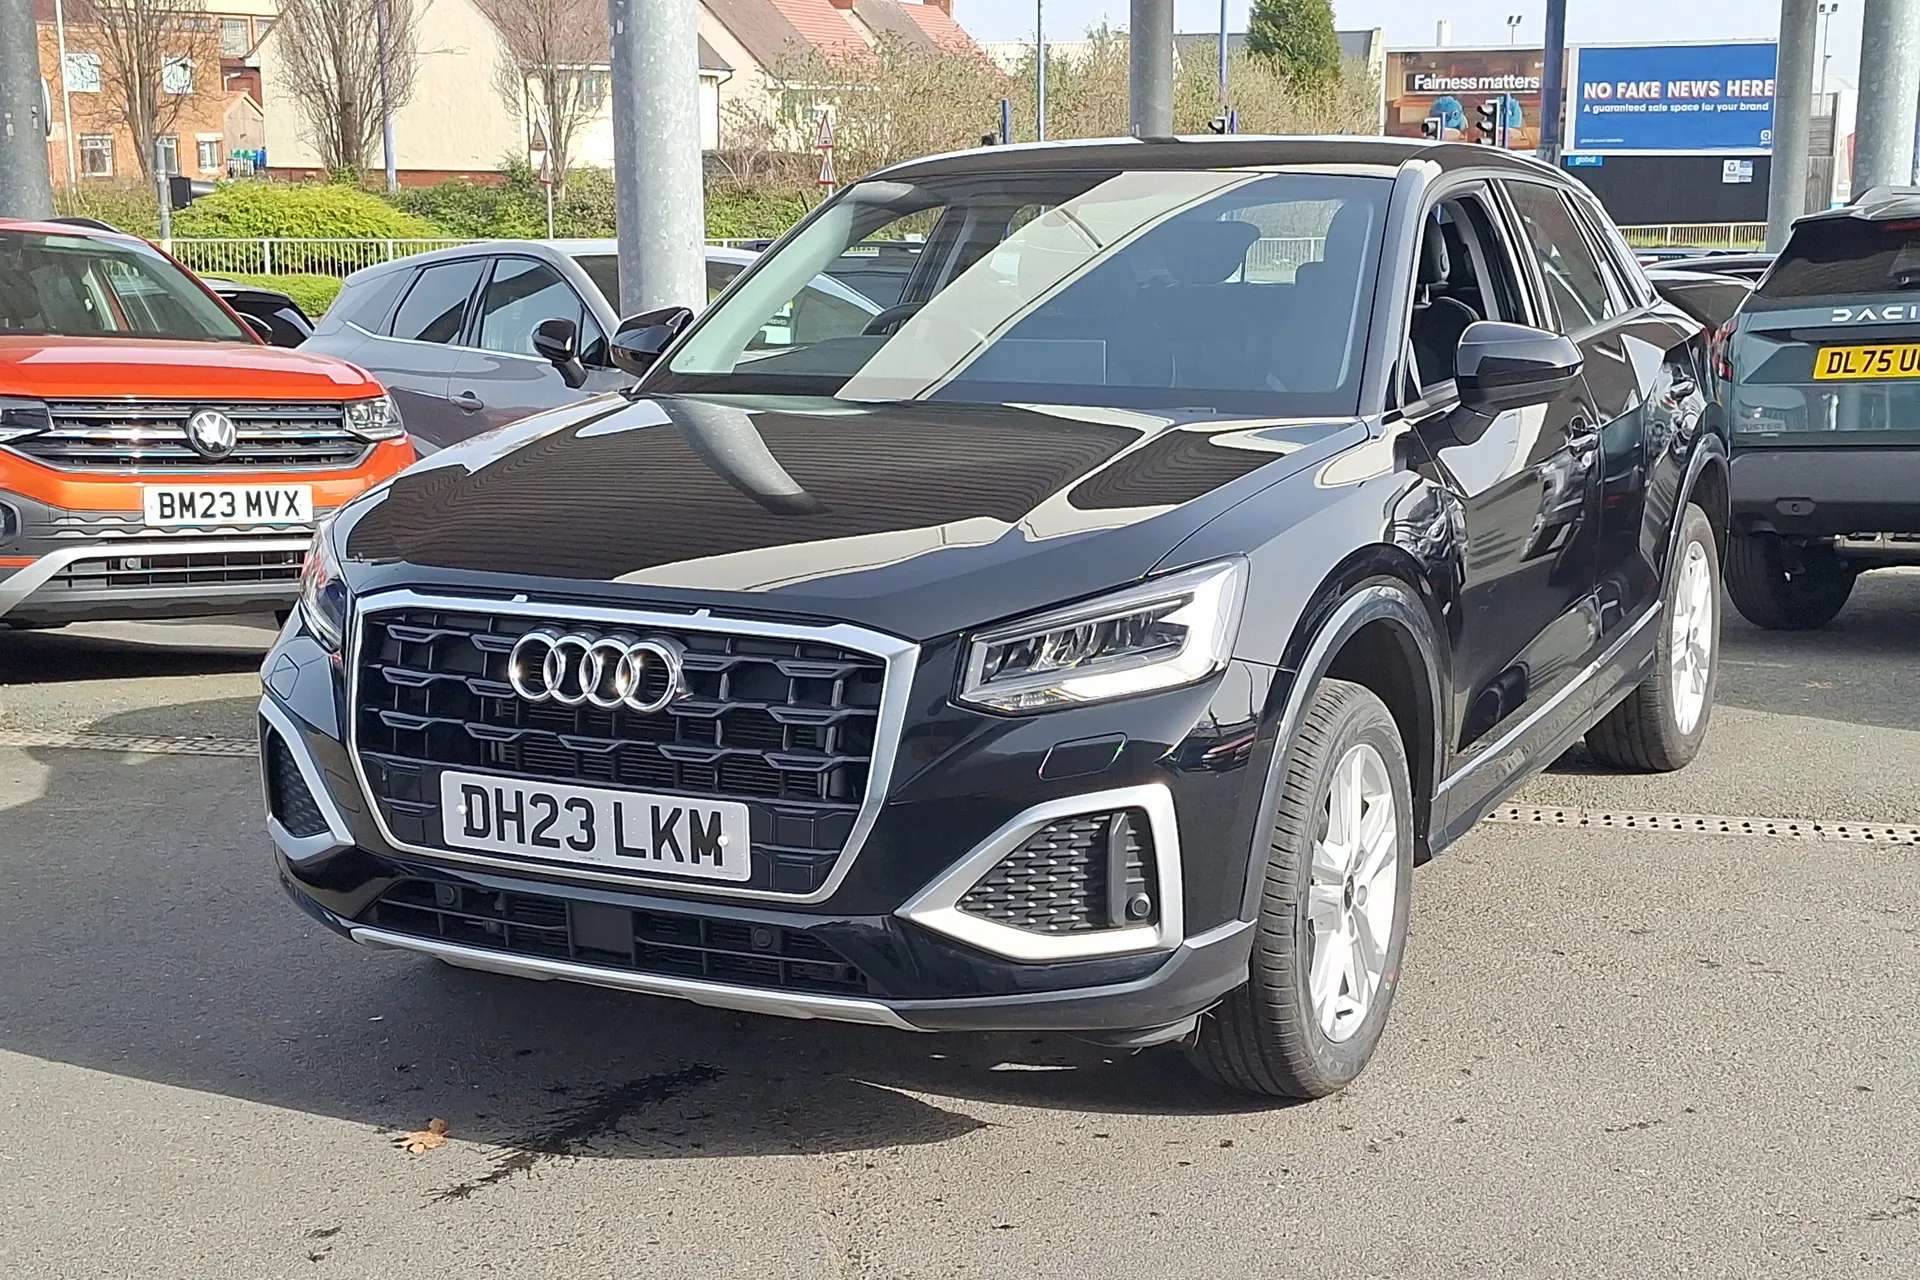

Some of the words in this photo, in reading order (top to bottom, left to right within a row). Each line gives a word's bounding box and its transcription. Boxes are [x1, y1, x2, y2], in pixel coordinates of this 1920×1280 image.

[1414, 73, 1477, 90] Fairness
[1478, 73, 1540, 89] matters
[1583, 82, 1612, 99] NO
[1616, 81, 1660, 99] FAKE
[1667, 80, 1720, 98] NEWS
[1726, 79, 1775, 97] HERE
[1584, 104, 1590, 112] A
[1592, 103, 1646, 114] guaranteed
[1648, 103, 1668, 112] safe
[1670, 103, 1699, 113] space
[1701, 103, 1715, 112] for
[1717, 103, 1739, 113] your
[1740, 102, 1769, 111] brand
[1826, 349, 1894, 375] DL75
[1899, 348, 1920, 372] U
[158, 492, 236, 520] BM23
[246, 490, 301, 518] MVX
[461, 783, 597, 852] DH23
[613, 801, 724, 867] LKM
